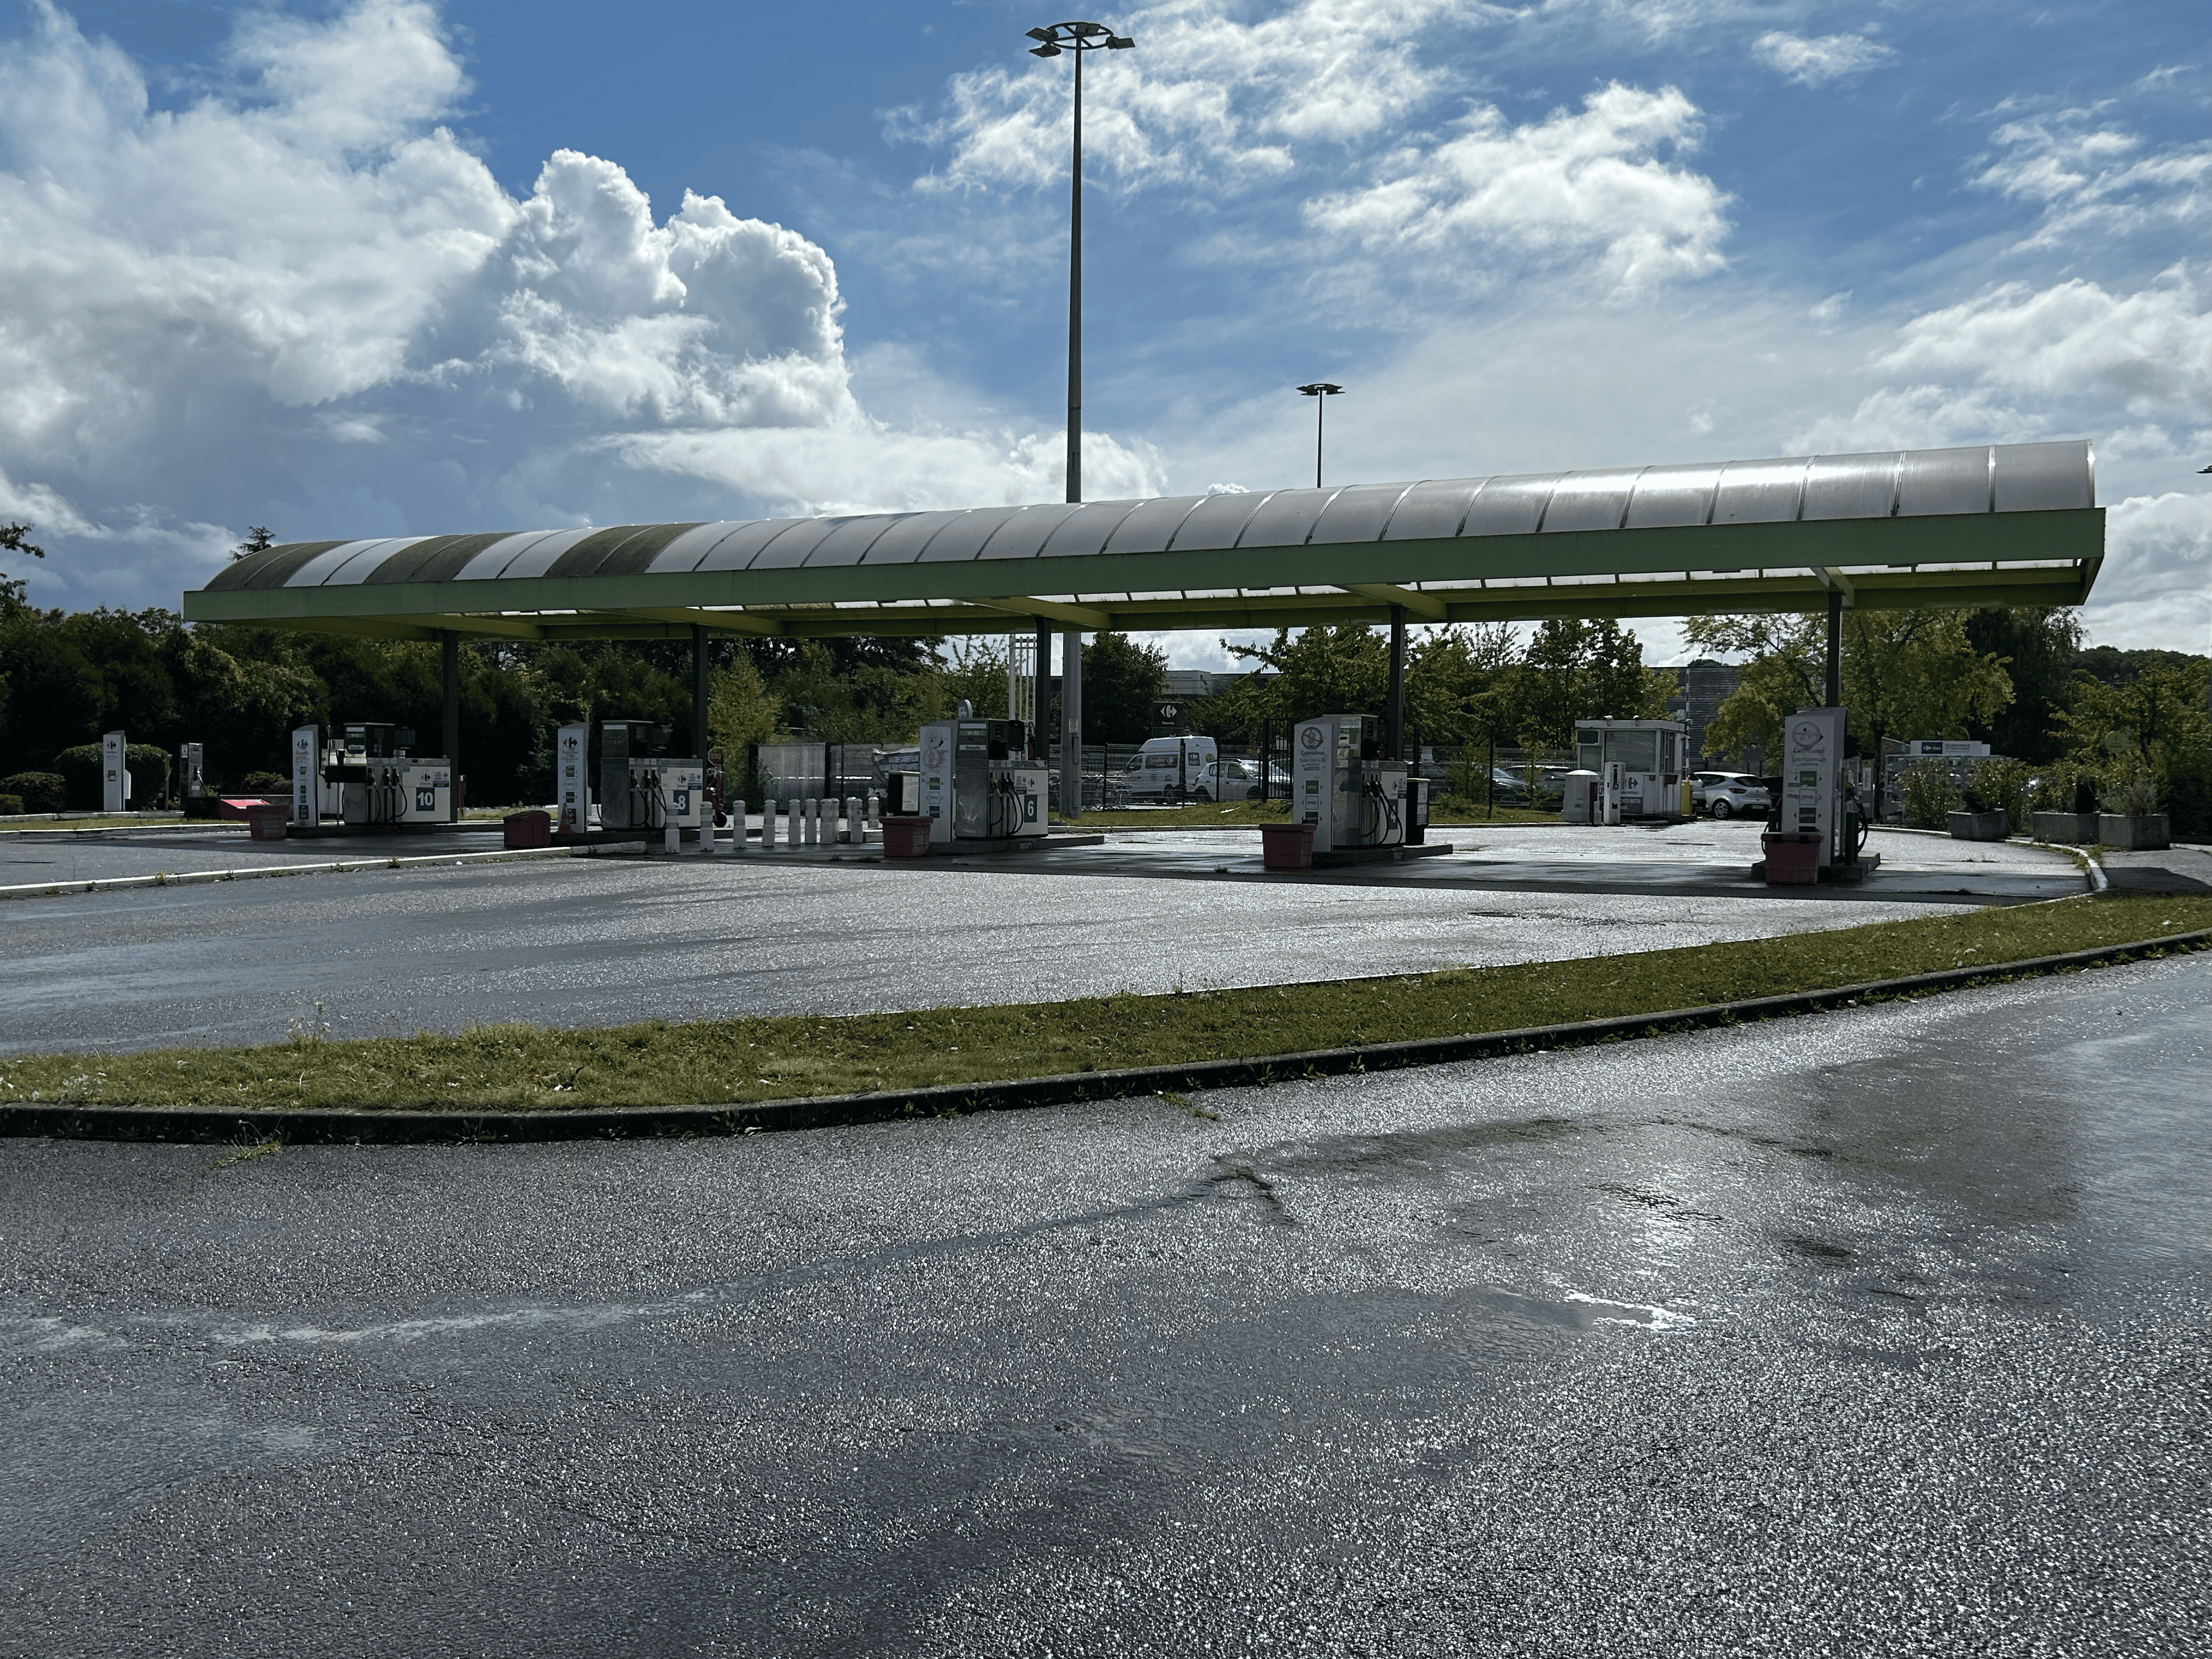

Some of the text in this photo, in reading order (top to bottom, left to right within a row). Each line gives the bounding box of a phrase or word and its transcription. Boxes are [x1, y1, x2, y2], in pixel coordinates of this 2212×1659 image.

[417, 792, 433, 806] 10
[678, 795, 686, 810] 8
[1027, 800, 1034, 817] 6
[1390, 805, 1396, 823] 4
